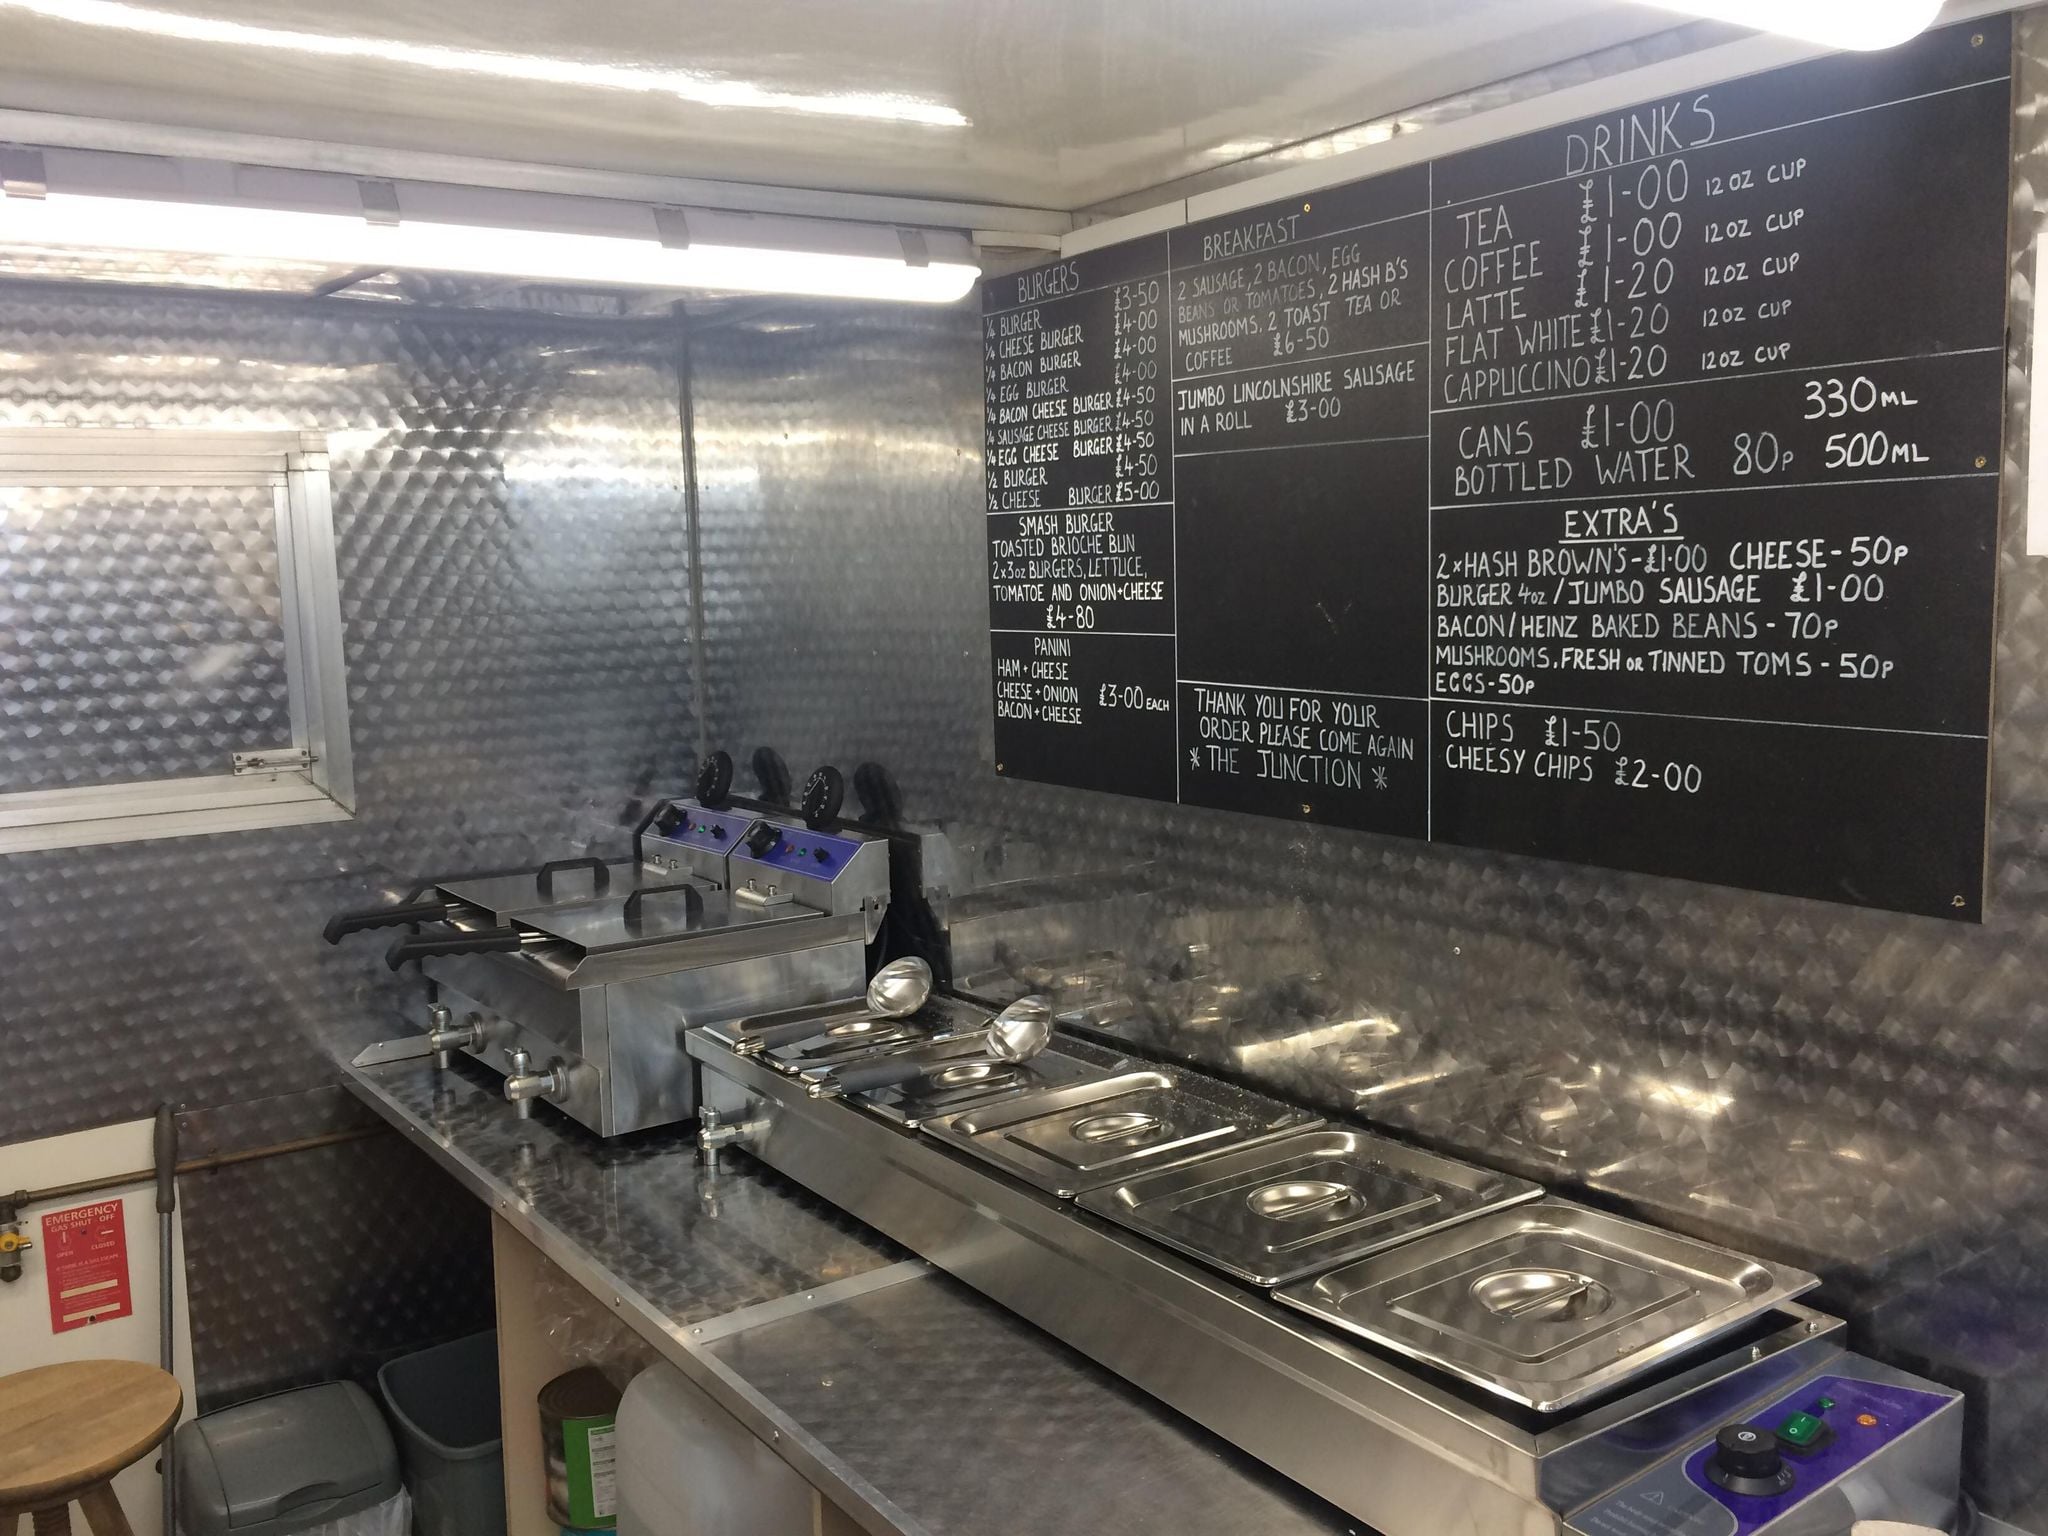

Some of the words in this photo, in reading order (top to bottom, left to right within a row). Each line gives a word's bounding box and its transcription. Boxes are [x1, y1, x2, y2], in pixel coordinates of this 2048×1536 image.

[1566, 94, 1715, 176] DRINKS
[1457, 205, 1512, 249] TEA
[1768, 158, 1806, 184] CUP
[1204, 214, 1300, 261] BREAKFAST
[1444, 240, 1544, 293] COFFEE
[1766, 208, 1804, 232] CUP
[1018, 261, 1079, 303] BURGERS
[1178, 282, 1186, 300] 2
[1254, 263, 1262, 285] 2
[1268, 252, 1326, 282] BACON,
[1332, 243, 1361, 269] EGG
[1179, 304, 1214, 324] BEANS
[1224, 297, 1239, 314] OR
[1328, 274, 1338, 294] 2
[1343, 264, 1380, 291] HASH
[1386, 257, 1408, 282] B'S
[1446, 287, 1527, 330] LATTE
[1762, 252, 1799, 276] CUP
[1001, 309, 1042, 336] BURGER
[1268, 311, 1276, 331] 2
[1284, 302, 1330, 328] TOAST
[1346, 295, 1372, 316] TEA
[1380, 288, 1401, 310] OR
[1000, 335, 1034, 358] CHEESE
[1041, 324, 1083, 351] BURGER
[1446, 328, 1504, 367] FLAT
[1516, 314, 1584, 355] WHITE
[1758, 299, 1792, 319] CUP
[1001, 360, 1032, 380] BACON
[1040, 351, 1081, 373] BURGER
[1186, 347, 1232, 372] COFFEE
[1444, 356, 1591, 404] CAPPUCCINO
[1754, 342, 1791, 362] CUP
[1001, 383, 1019, 403] EGG
[1026, 376, 1069, 399] BURGER
[1178, 385, 1225, 410] JUMBO
[1234, 371, 1333, 404] LINCOLNSHIRE
[1344, 360, 1415, 390] SAUSAGE
[1000, 405, 1028, 424] BACON
[1032, 400, 1067, 419] CHEESE
[1073, 392, 1113, 414] BURGER
[1181, 417, 1194, 436] IN
[1200, 417, 1209, 433] A
[1216, 410, 1252, 432] ROLL
[998, 426, 1034, 445] SAUSAGE
[1038, 422, 1069, 440] CHEESE
[1074, 415, 1113, 437] BURGER
[1458, 421, 1532, 459] CANS
[998, 447, 1017, 466] EGG
[1023, 443, 1059, 463] CHEESE
[1073, 436, 1113, 458] BURGER
[1004, 467, 1048, 488] BURGER
[1455, 458, 1572, 497] BOTTLED
[1594, 443, 1695, 485] WATER
[1002, 490, 1041, 509] CHEESE
[1069, 485, 1112, 506] BURGER
[1019, 515, 1058, 536] SMASH
[1066, 512, 1114, 534] BURGER
[1565, 501, 1678, 538] EXTRA'S
[992, 538, 1044, 558] TOASTED
[1052, 535, 1102, 556] BRIOCHE
[1109, 533, 1135, 553] BUN
[993, 584, 1044, 601] TOMATOE
[1052, 583, 1072, 601] AND
[1437, 583, 1512, 607] BURGER
[1659, 574, 1761, 604] SAUSAGE
[1592, 613, 1660, 638] BAKED
[1673, 611, 1758, 639] BEANS
[1034, 637, 1071, 656] PANINI
[1561, 647, 1621, 670] FRESH
[1648, 650, 1725, 672] TINNED
[1736, 651, 1812, 676] TOMS
[998, 658, 1020, 677] HAM
[1032, 661, 1069, 680] CHEESE
[997, 681, 1032, 700] CHEESE
[1043, 684, 1078, 703] ONION
[1146, 698, 1169, 711] EACH
[998, 701, 1032, 719] BACON
[1042, 705, 1082, 724] CHEESE
[1194, 688, 1246, 716] THANK
[1255, 694, 1283, 719] YOU
[1289, 698, 1322, 724] FOR
[1332, 701, 1380, 729] YOUR
[1200, 716, 1254, 744] ORDER
[1260, 722, 1311, 749] PLEASE
[1320, 729, 1362, 755] COME
[1368, 735, 1414, 761] AGAIN
[1446, 710, 1513, 742] CHIPS
[1206, 745, 1239, 774] THE
[1257, 749, 1361, 789] JUNCTION
[1446, 744, 1525, 774] CHEESY
[1534, 751, 1592, 782] CHIPS
[45, 1203, 118, 1226] EMERGENCY
[51, 1225, 68, 1233] GAS
[70, 1219, 92, 1229] SHUT
[99, 1213, 115, 1222] OFF
